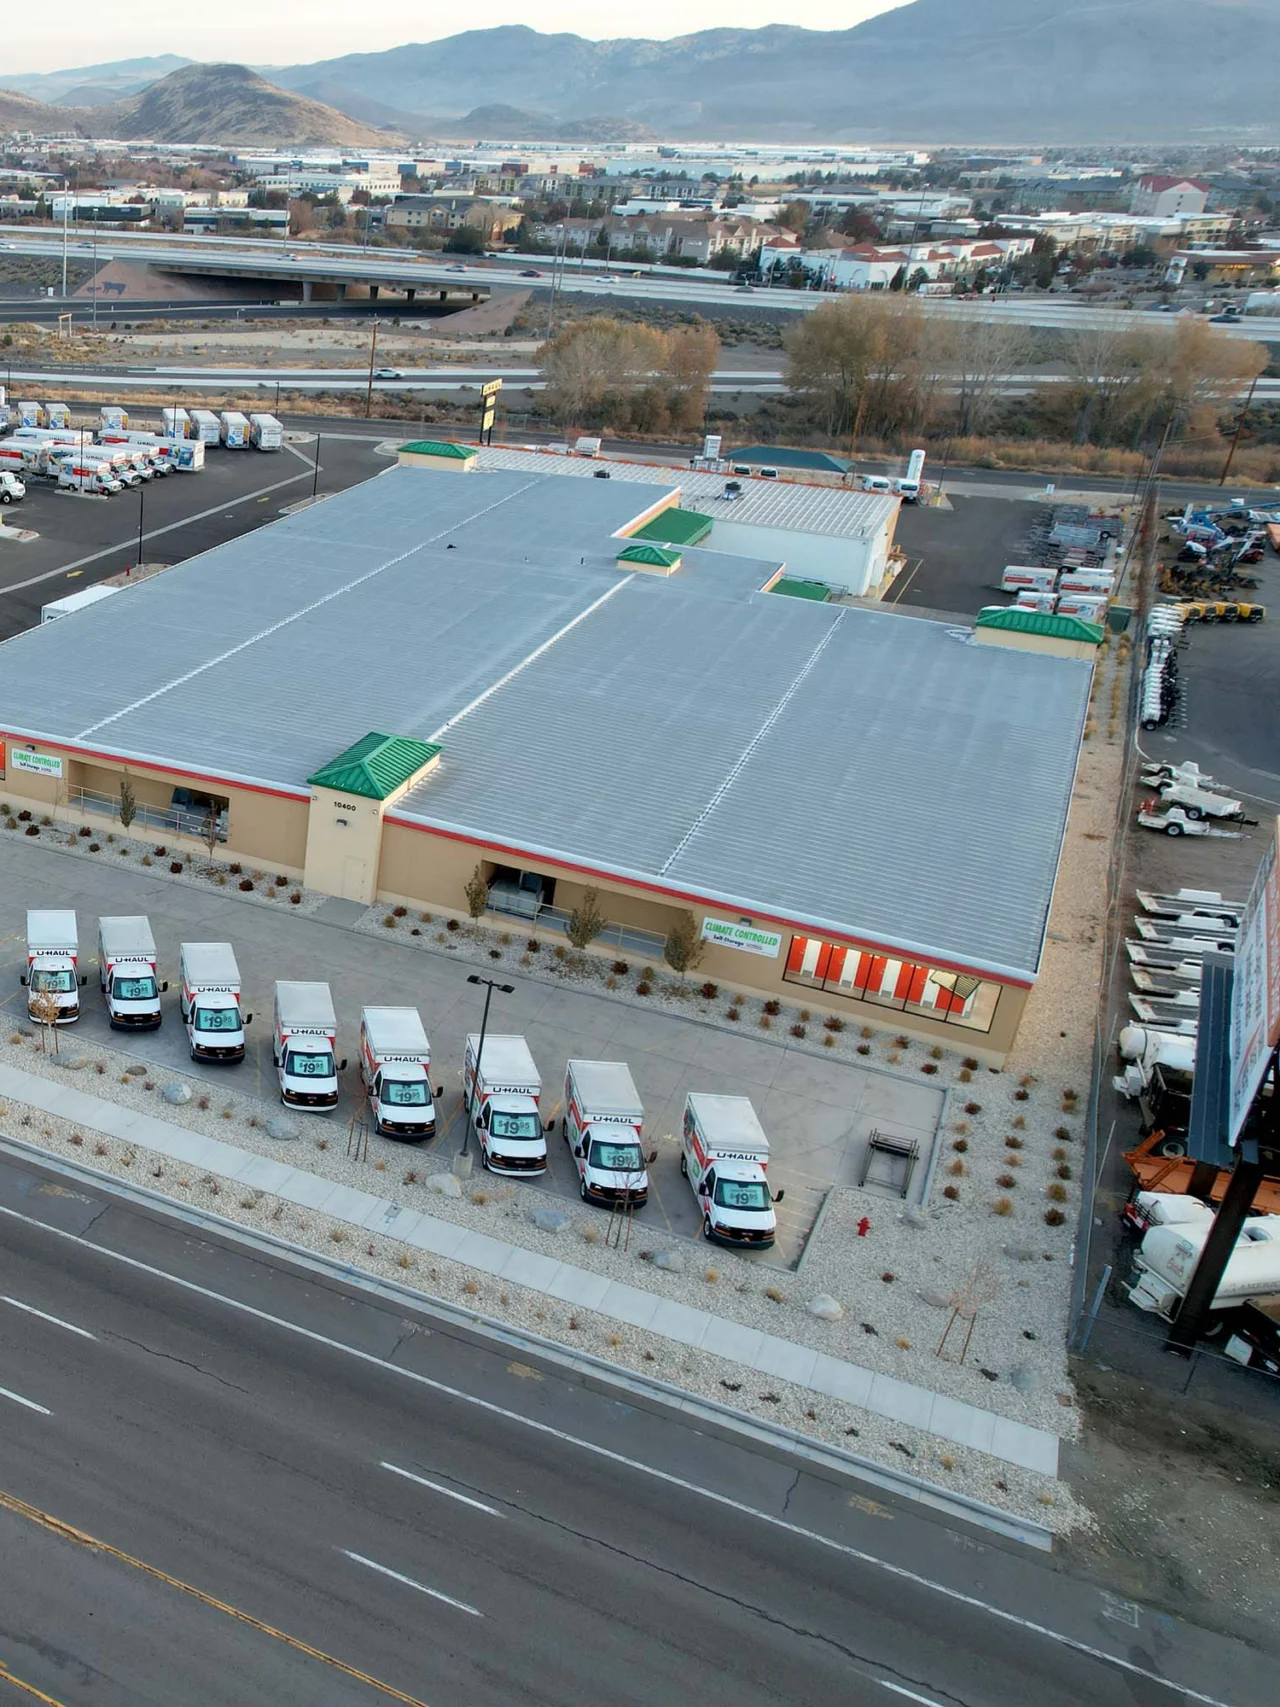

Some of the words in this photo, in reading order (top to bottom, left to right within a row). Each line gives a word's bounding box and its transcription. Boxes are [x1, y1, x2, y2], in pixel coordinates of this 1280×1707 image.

[32, 755, 60, 768] CONTROLLED
[334, 801, 357, 811] 10400
[705, 921, 734, 936] CLIMATE
[734, 929, 778, 947] CONTROLLED
[593, 1116, 634, 1124] U-HAUL
[716, 1152, 759, 1161] U-HAUL
